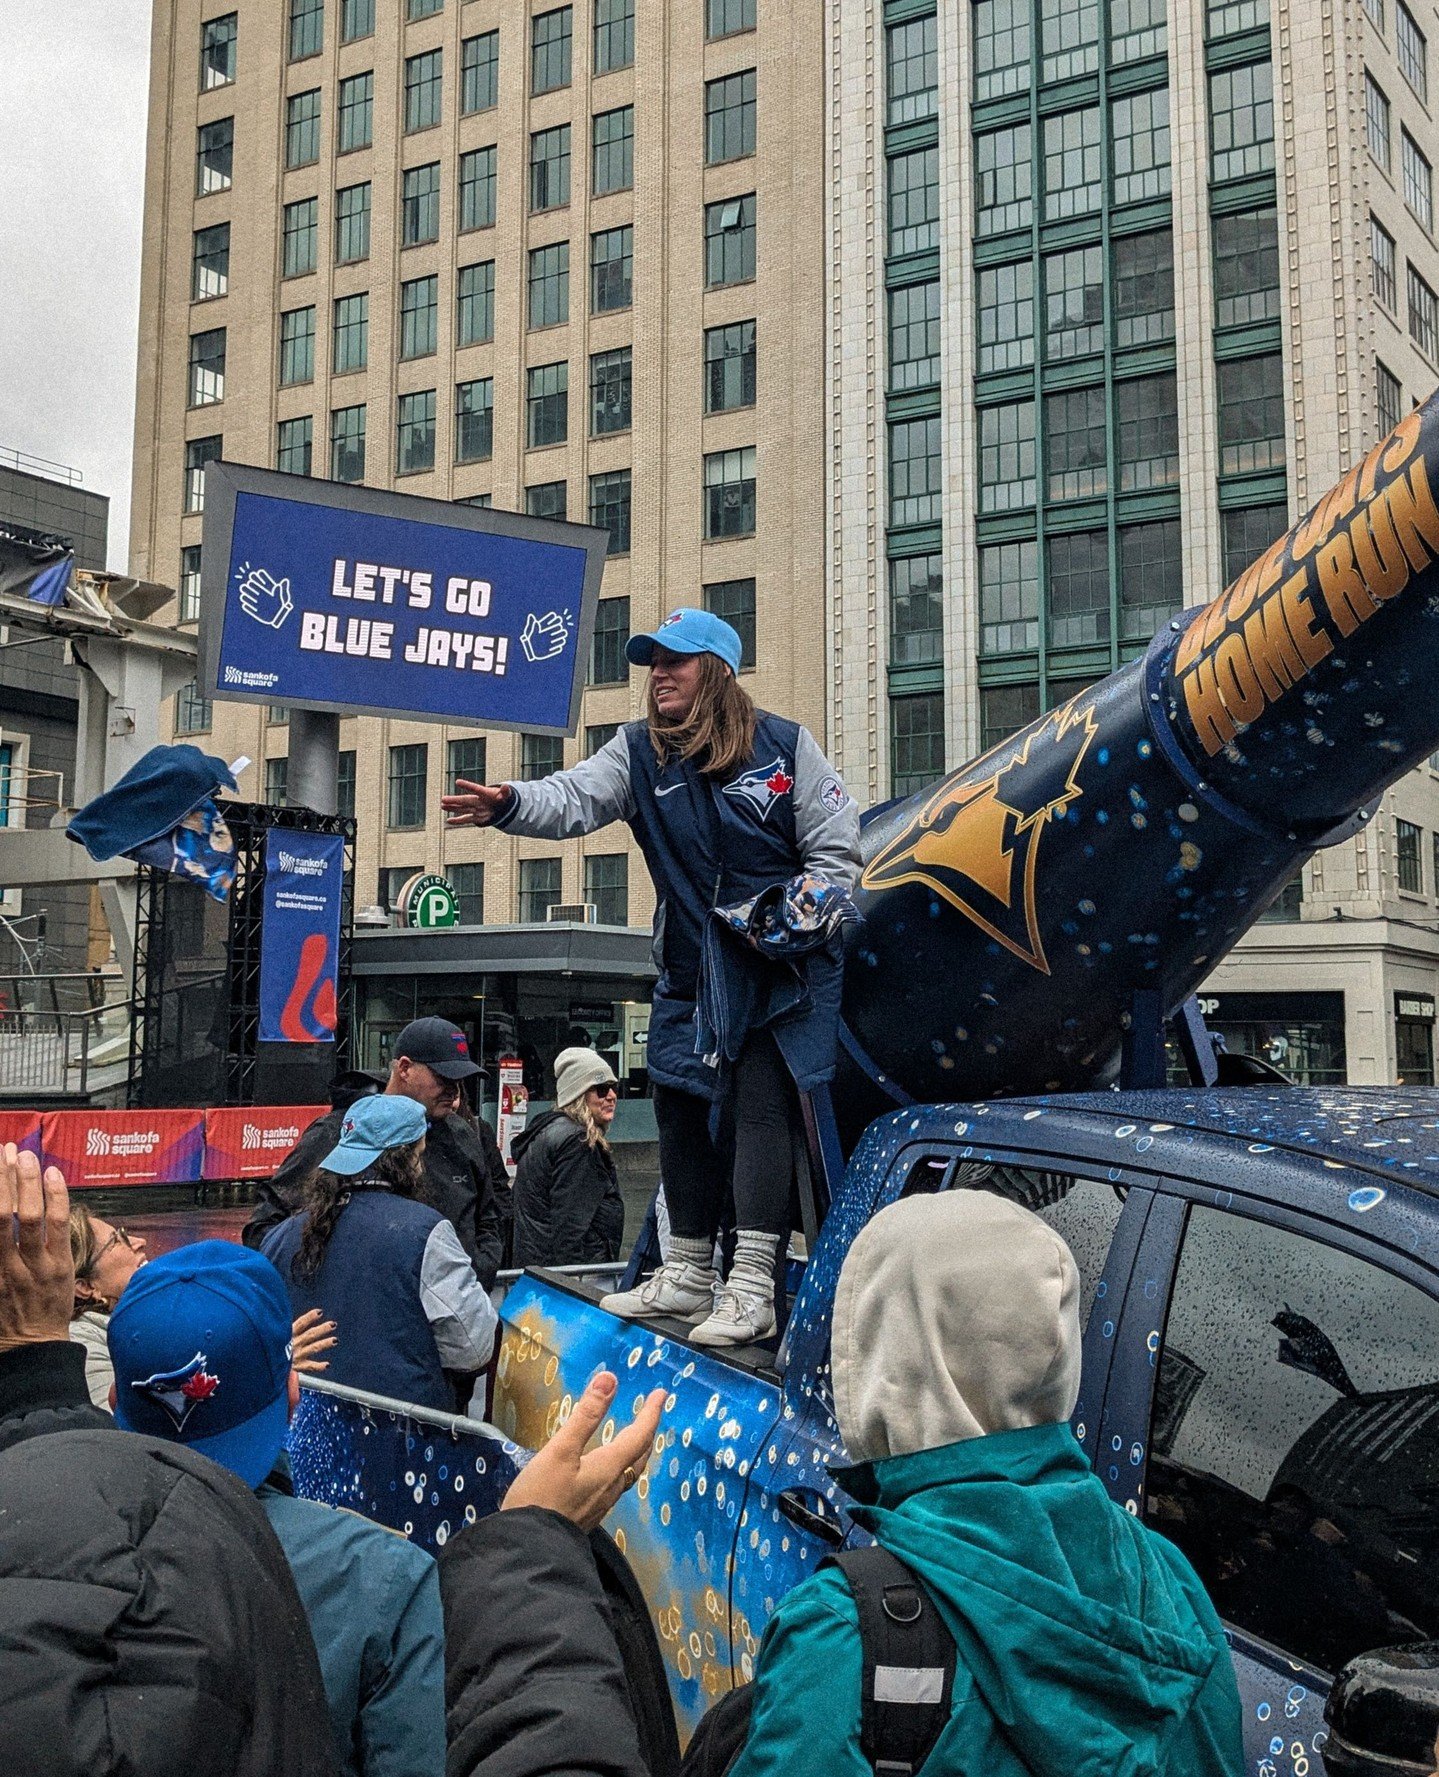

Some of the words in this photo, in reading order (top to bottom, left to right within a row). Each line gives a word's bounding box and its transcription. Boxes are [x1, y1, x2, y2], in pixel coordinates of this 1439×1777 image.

[332, 559, 432, 609] LET'S
[445, 577, 491, 617] GO
[1183, 566, 1334, 758] HOME
[1316, 455, 1439, 638] RUN
[300, 612, 394, 659] BLUE
[404, 627, 508, 675] JAYS!
[242, 672, 279, 682] sankofa
[242, 678, 273, 687] square
[295, 858, 328, 869] sankofa
[293, 866, 323, 876] square
[412, 877, 459, 906] MUNICIPAL
[275, 900, 323, 911] @sankofasquare
[429, 894, 449, 926] P
[112, 1131, 160, 1144] sankofa
[262, 1126, 299, 1139] sankofa
[111, 1144, 153, 1156] square
[262, 1138, 294, 1150] square
